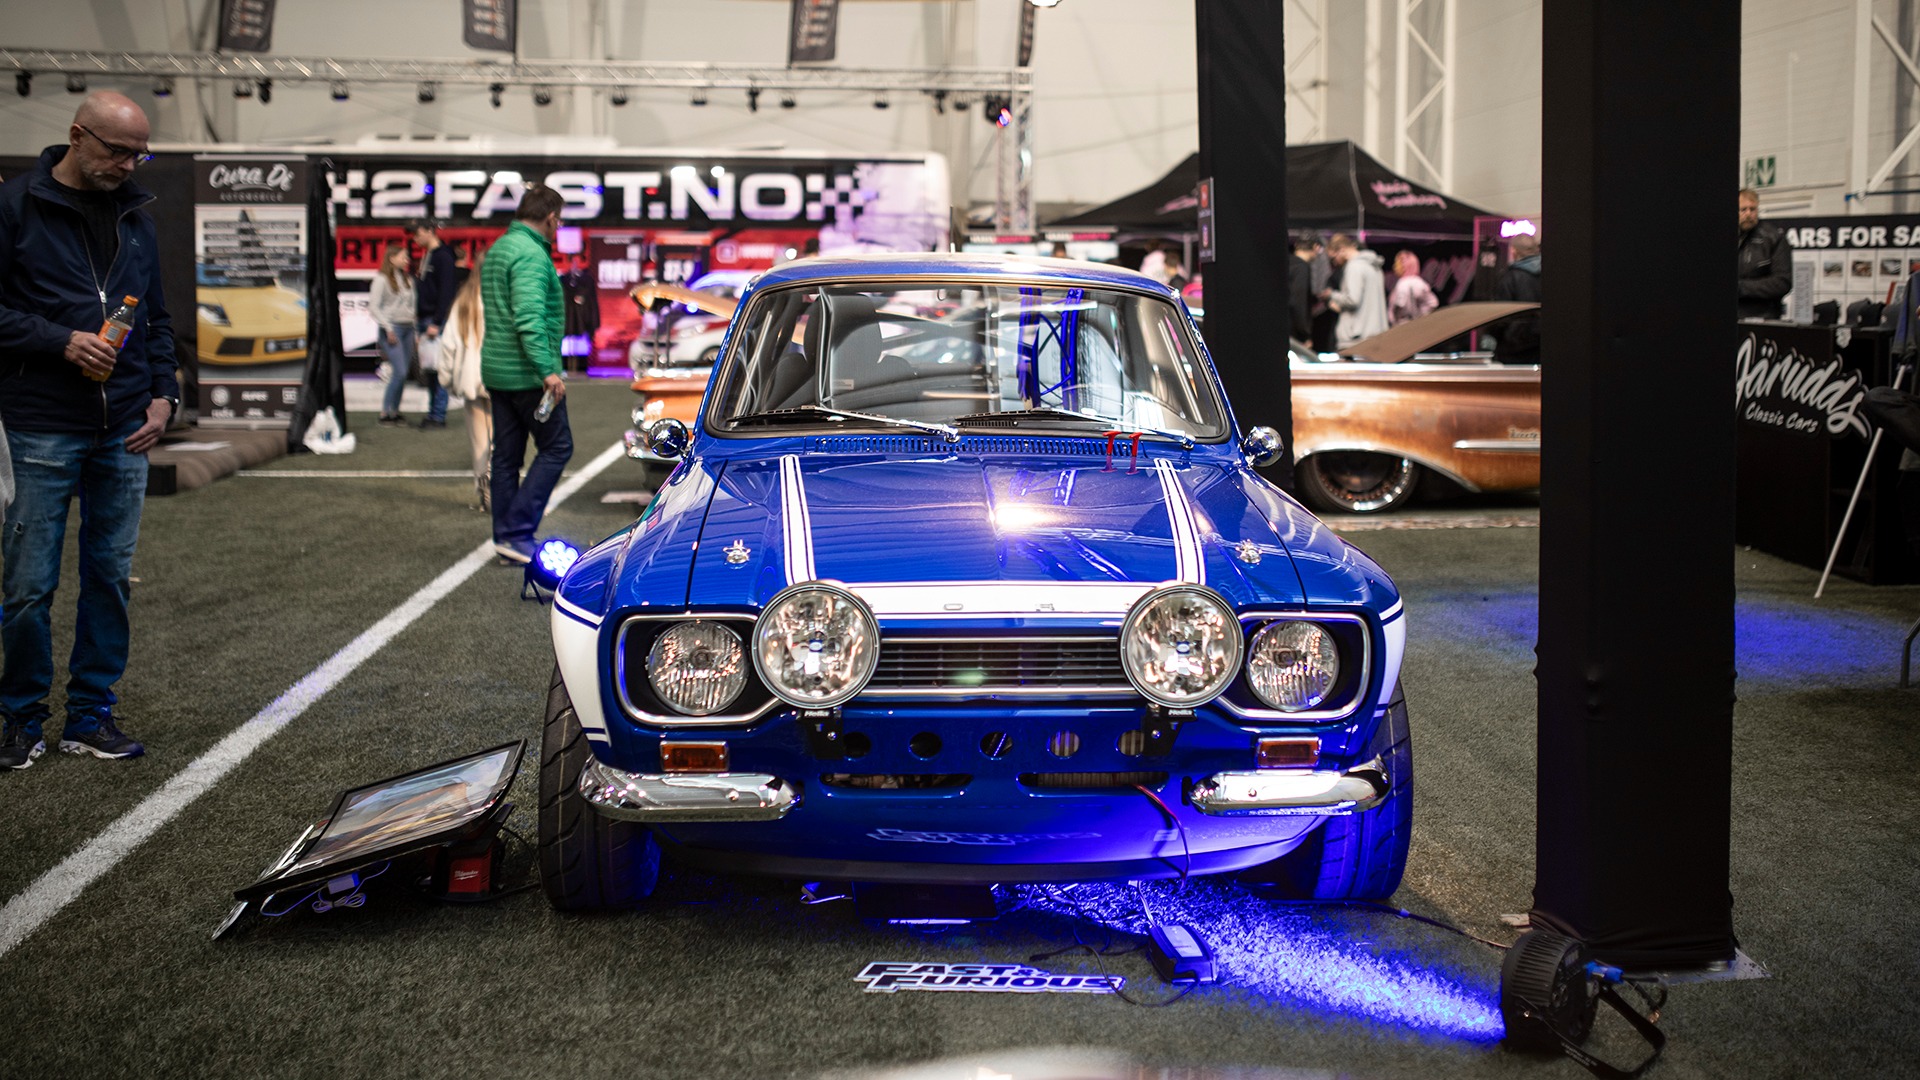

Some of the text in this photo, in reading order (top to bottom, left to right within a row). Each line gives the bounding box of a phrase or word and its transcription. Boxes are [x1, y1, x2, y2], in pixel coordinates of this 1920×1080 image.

[209, 163, 295, 192] Cura Di
[370, 169, 804, 221] 2FAST.NO
[1785, 226, 1832, 249] ARS
[1836, 226, 1888, 248] FOR
[1745, 401, 1819, 433] Classic Cars
[804, 709, 830, 718] Hella
[861, 963, 1014, 977] FAST
[872, 974, 1120, 990] FURIOUS
